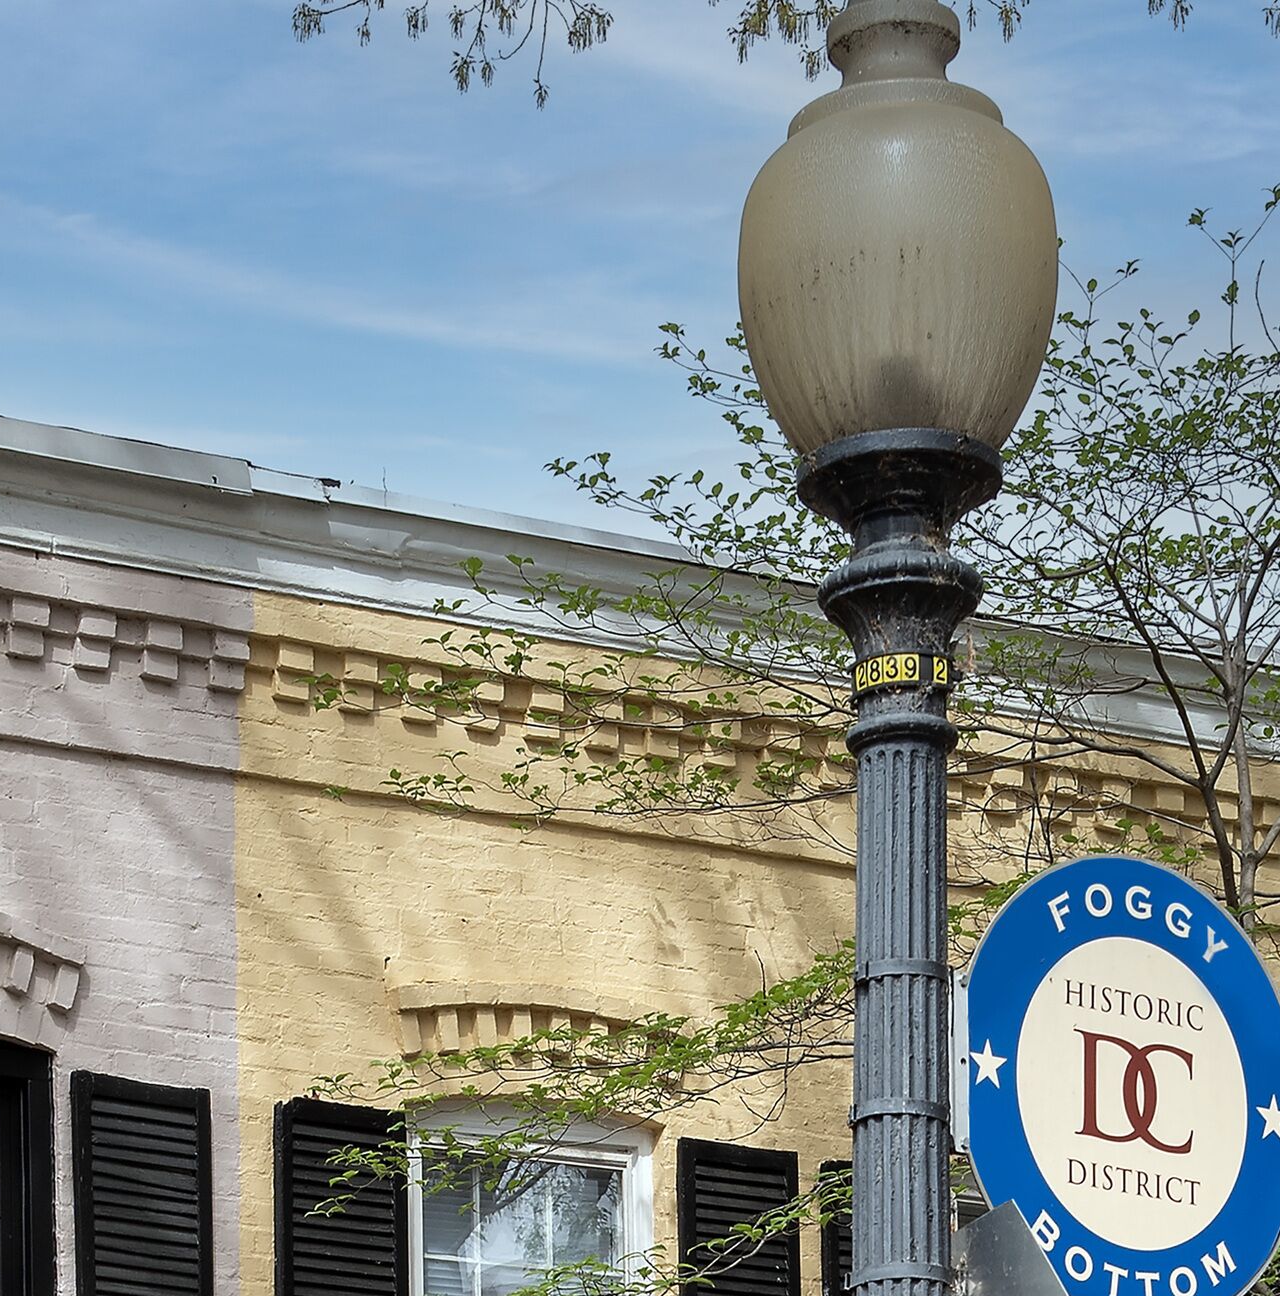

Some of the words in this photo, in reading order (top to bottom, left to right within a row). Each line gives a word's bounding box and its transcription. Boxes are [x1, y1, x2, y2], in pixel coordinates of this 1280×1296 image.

[857, 656, 917, 688] 2839
[935, 659, 946, 682] 2
[1047, 882, 1229, 964] FOGGY
[1063, 978, 1205, 1032] HISTORIC
[1072, 1028, 1194, 1155] DC
[1066, 1157, 1201, 1207] DISTRICT
